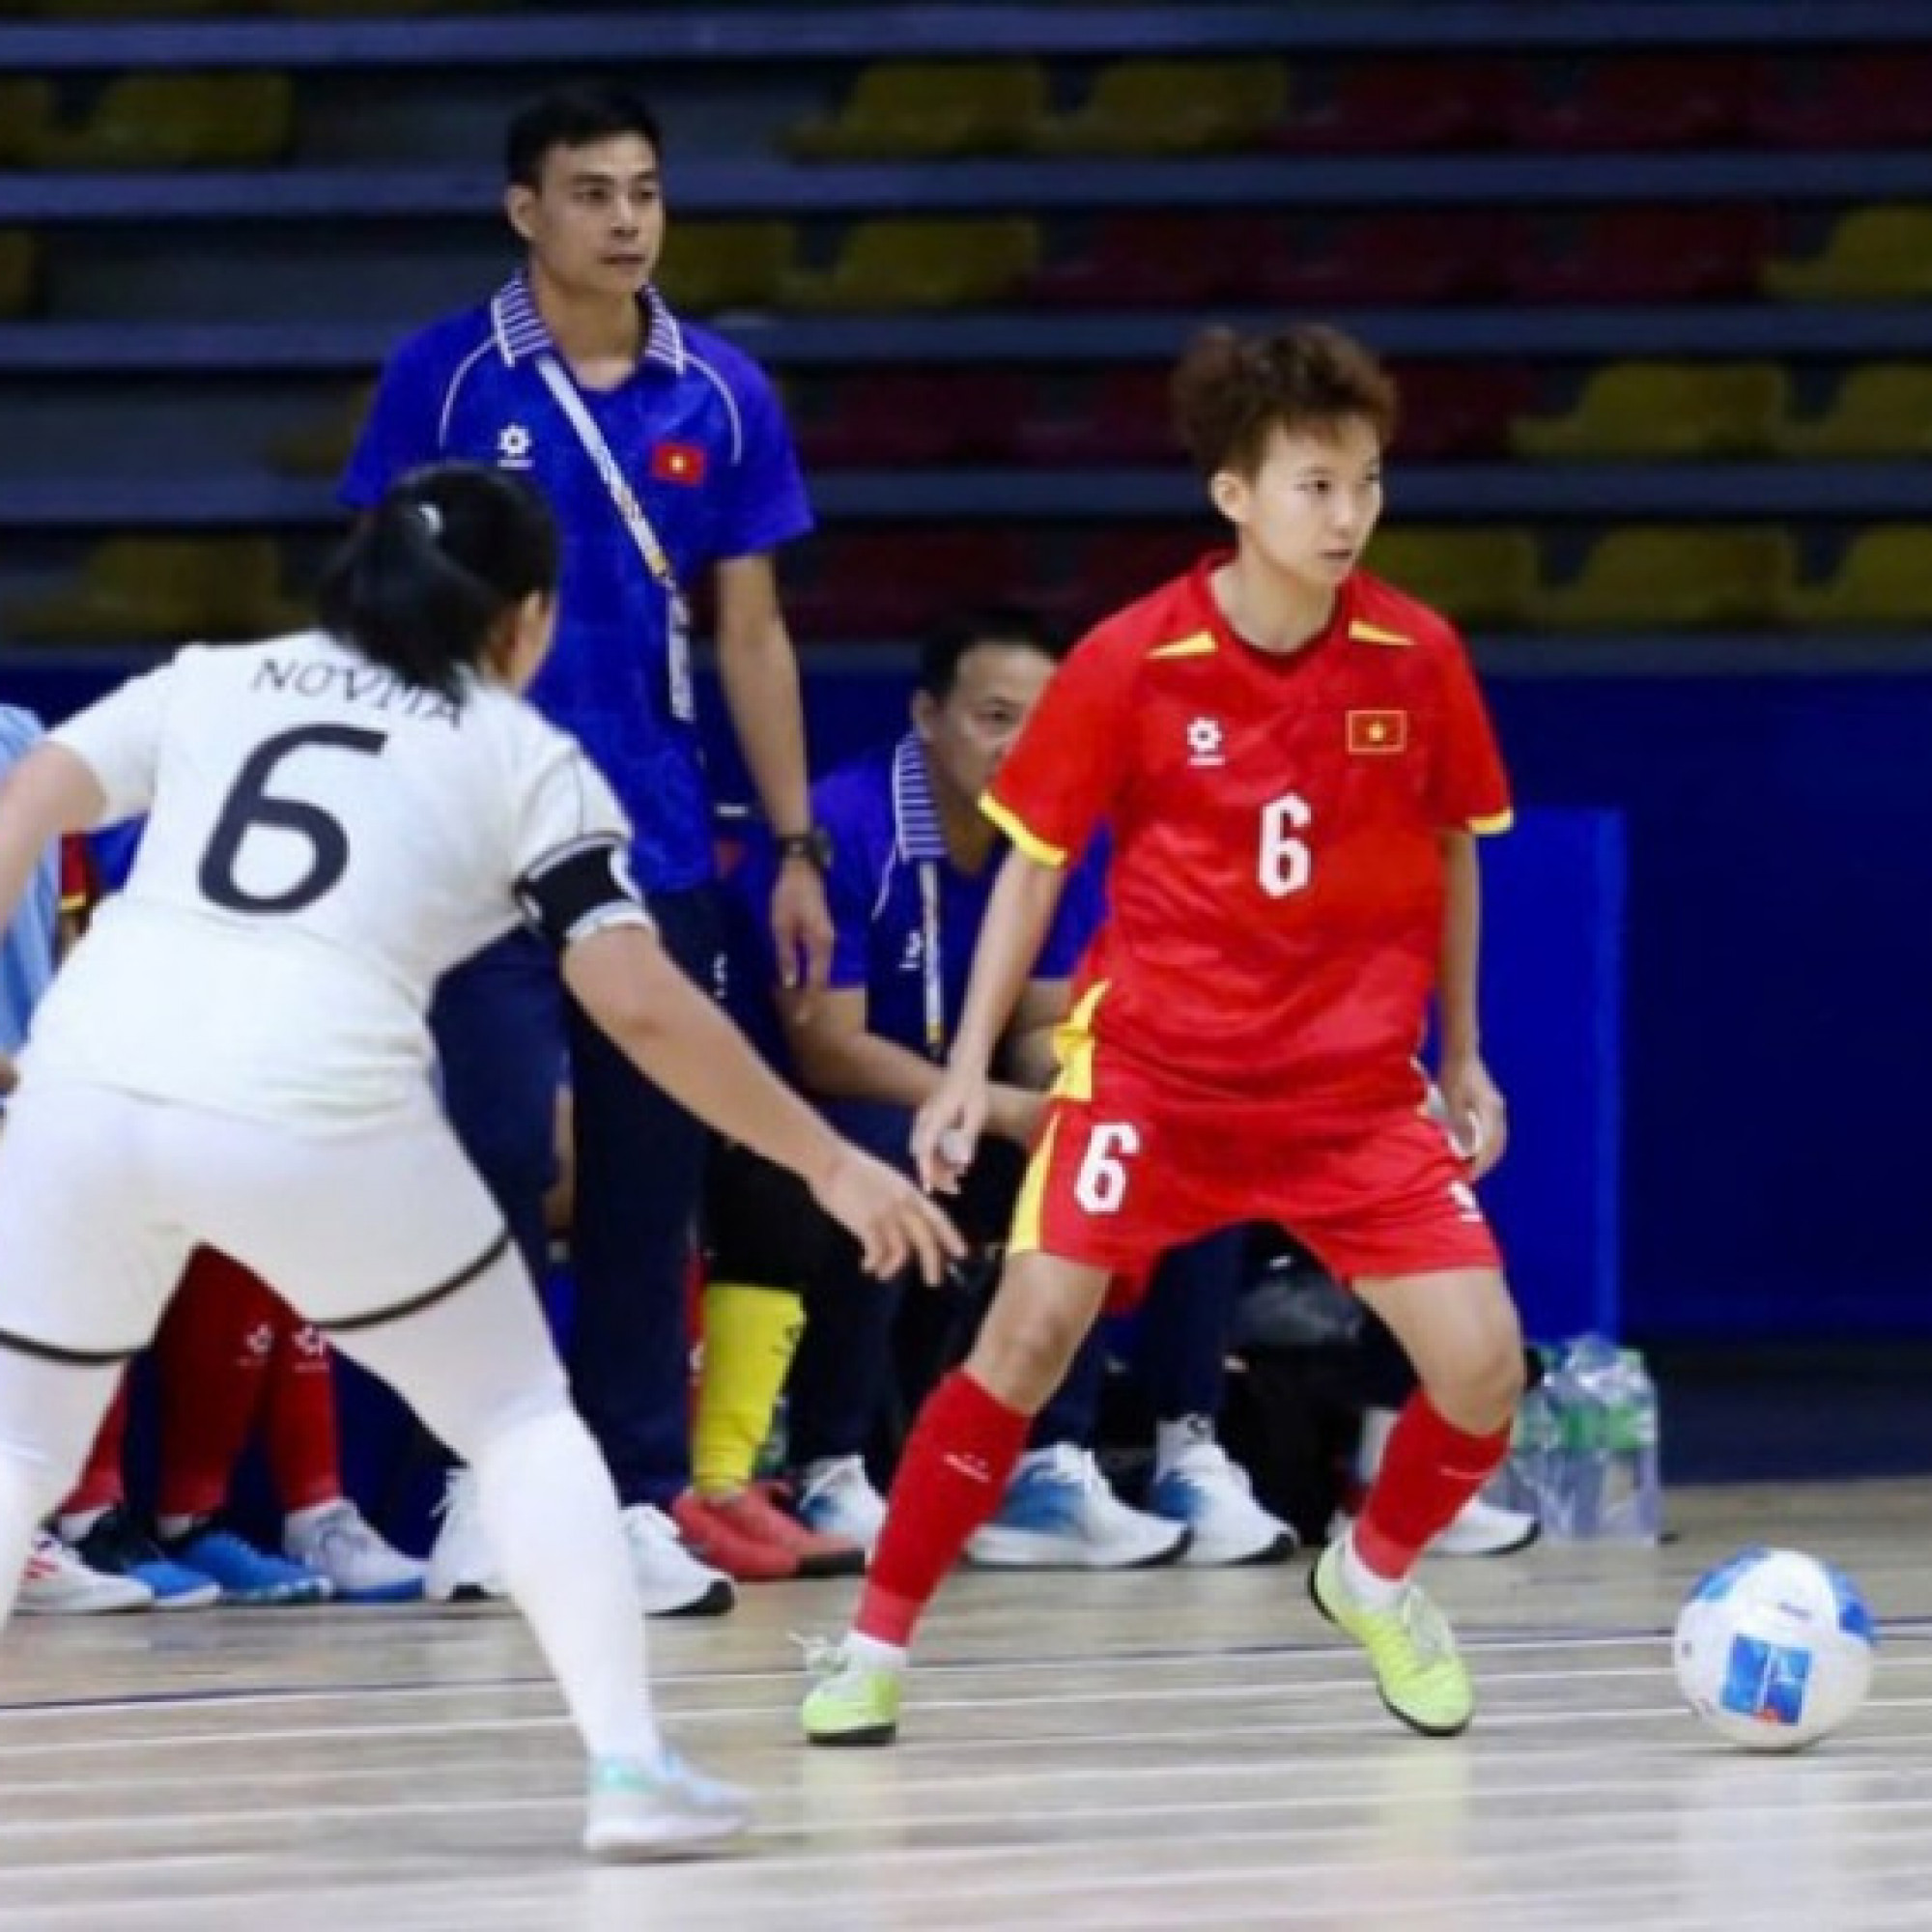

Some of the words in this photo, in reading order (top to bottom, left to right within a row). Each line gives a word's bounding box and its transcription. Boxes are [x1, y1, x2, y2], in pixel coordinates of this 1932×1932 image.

[198, 722, 387, 916] 6
[1259, 793, 1312, 898] 6
[1074, 1122, 1140, 1214] 6
